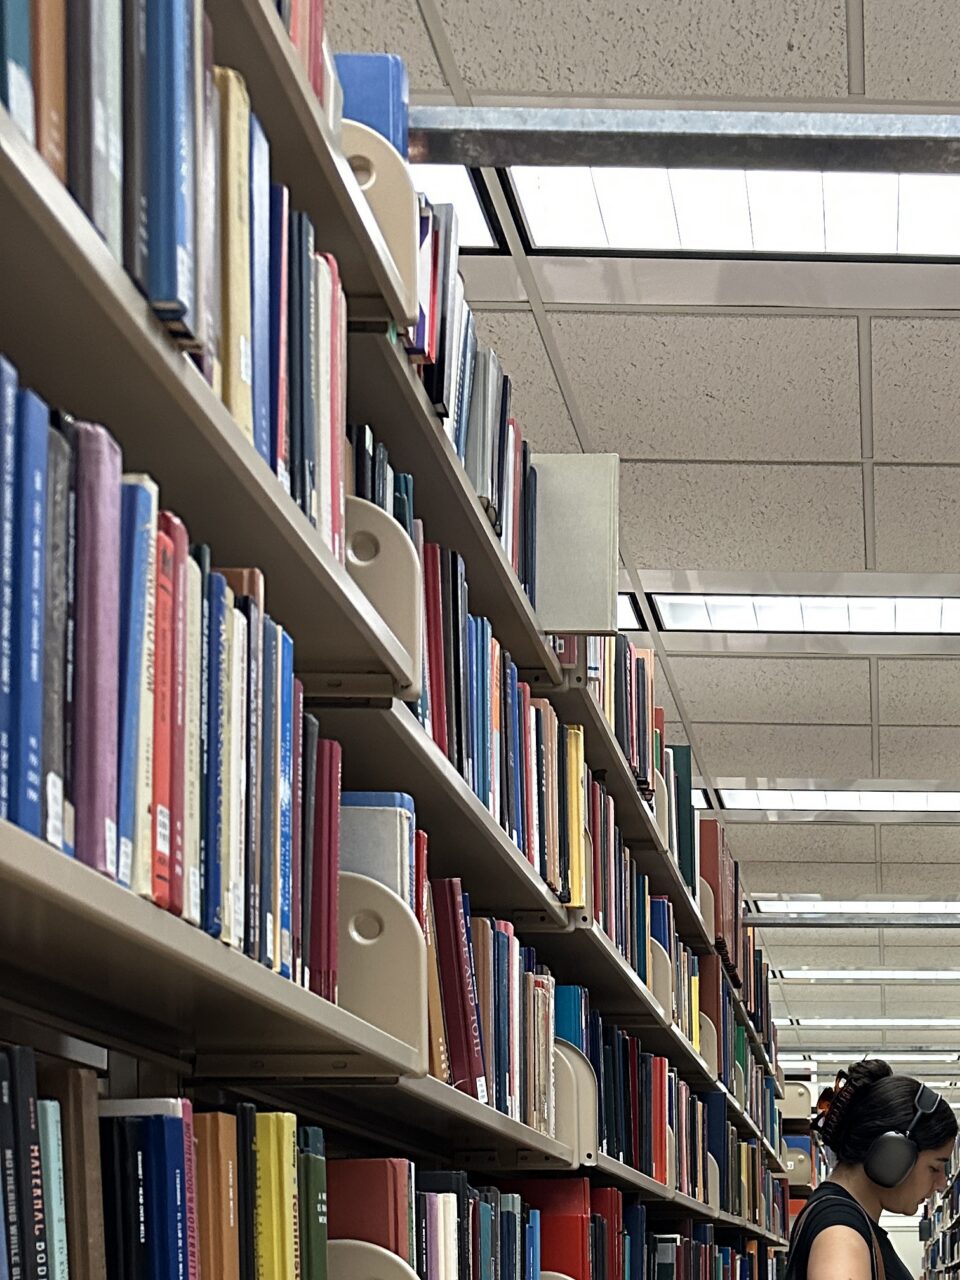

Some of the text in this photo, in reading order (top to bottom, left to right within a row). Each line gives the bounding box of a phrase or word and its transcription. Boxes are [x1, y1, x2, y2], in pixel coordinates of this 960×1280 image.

[146, 647, 155, 694] MOM
[458, 907, 480, 1058] LOVE AND TOIL
[4, 1148, 15, 1223] MOTHERING
[30, 1144, 44, 1237] MATERNAL
[184, 1120, 194, 1195] MOTHERHOOD
[9, 1224, 20, 1265] WHILE
[188, 1203, 197, 1280] MODERNITY
